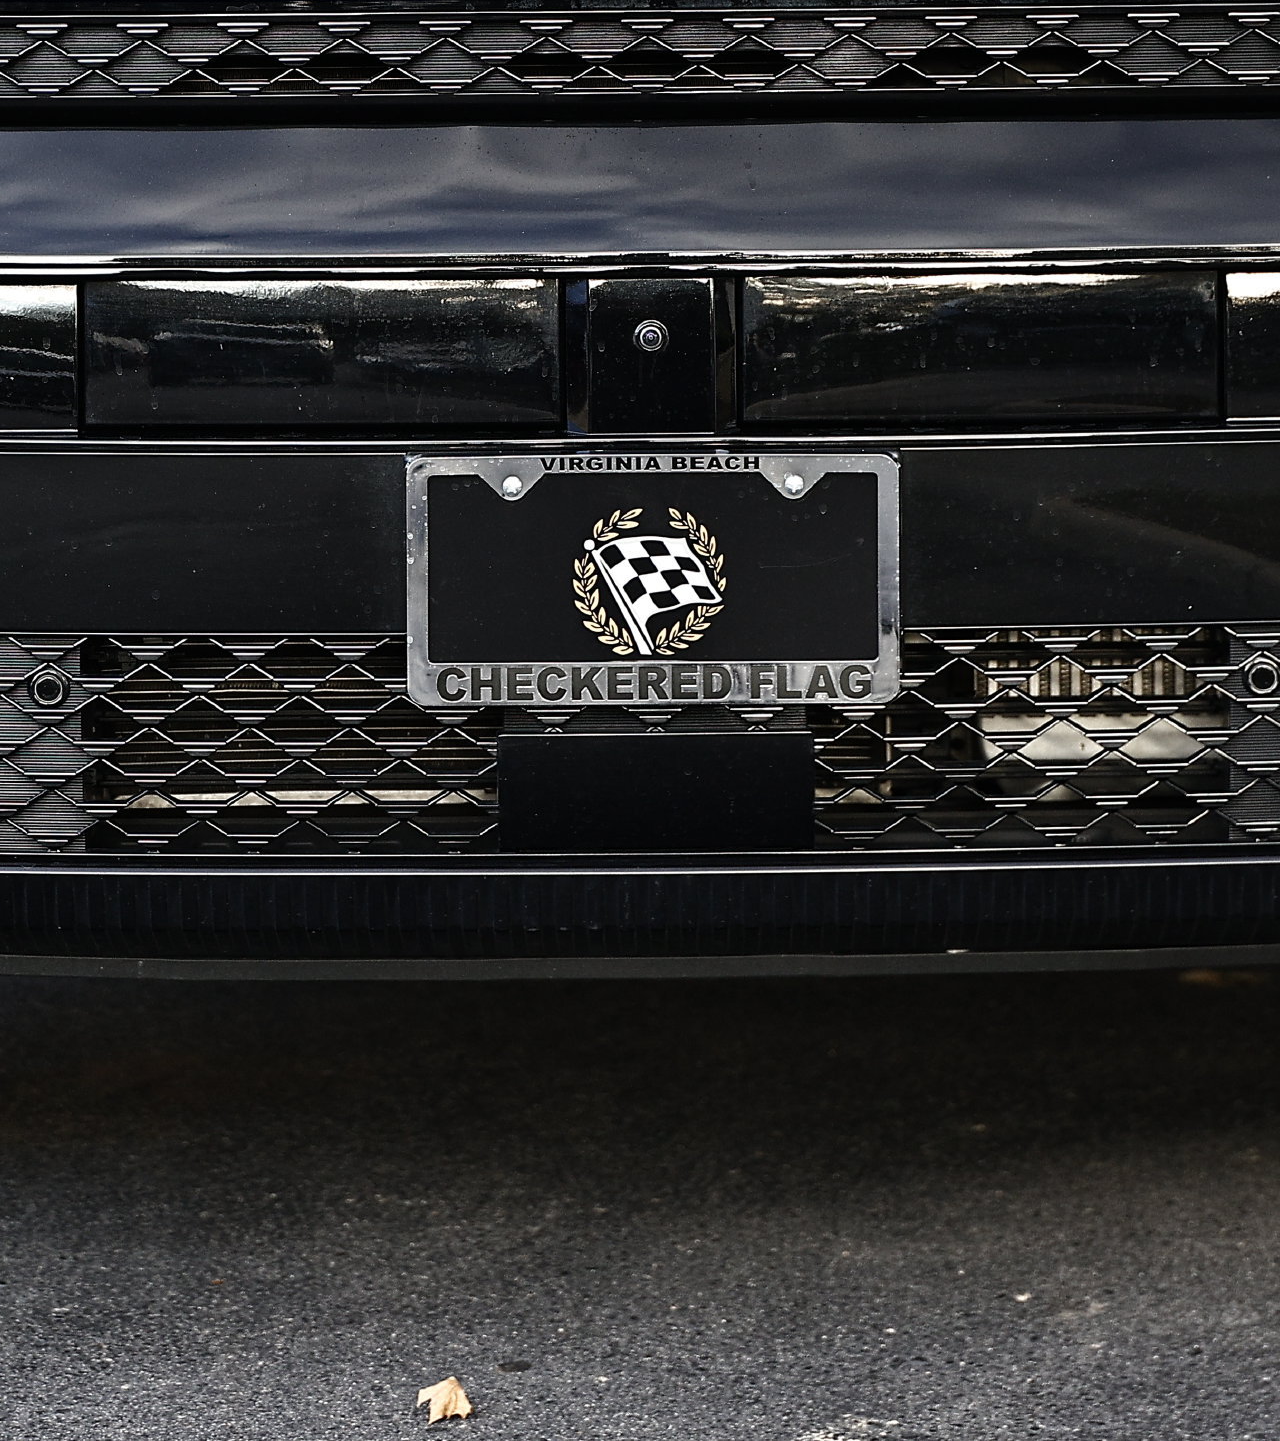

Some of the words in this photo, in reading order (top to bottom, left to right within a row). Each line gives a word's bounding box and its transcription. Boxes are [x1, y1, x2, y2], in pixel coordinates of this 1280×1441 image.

[539, 456, 662, 471] VIRGINIA
[671, 456, 761, 471] BEACH
[435, 664, 733, 702] CHECKERED
[750, 664, 873, 701] FLAG
